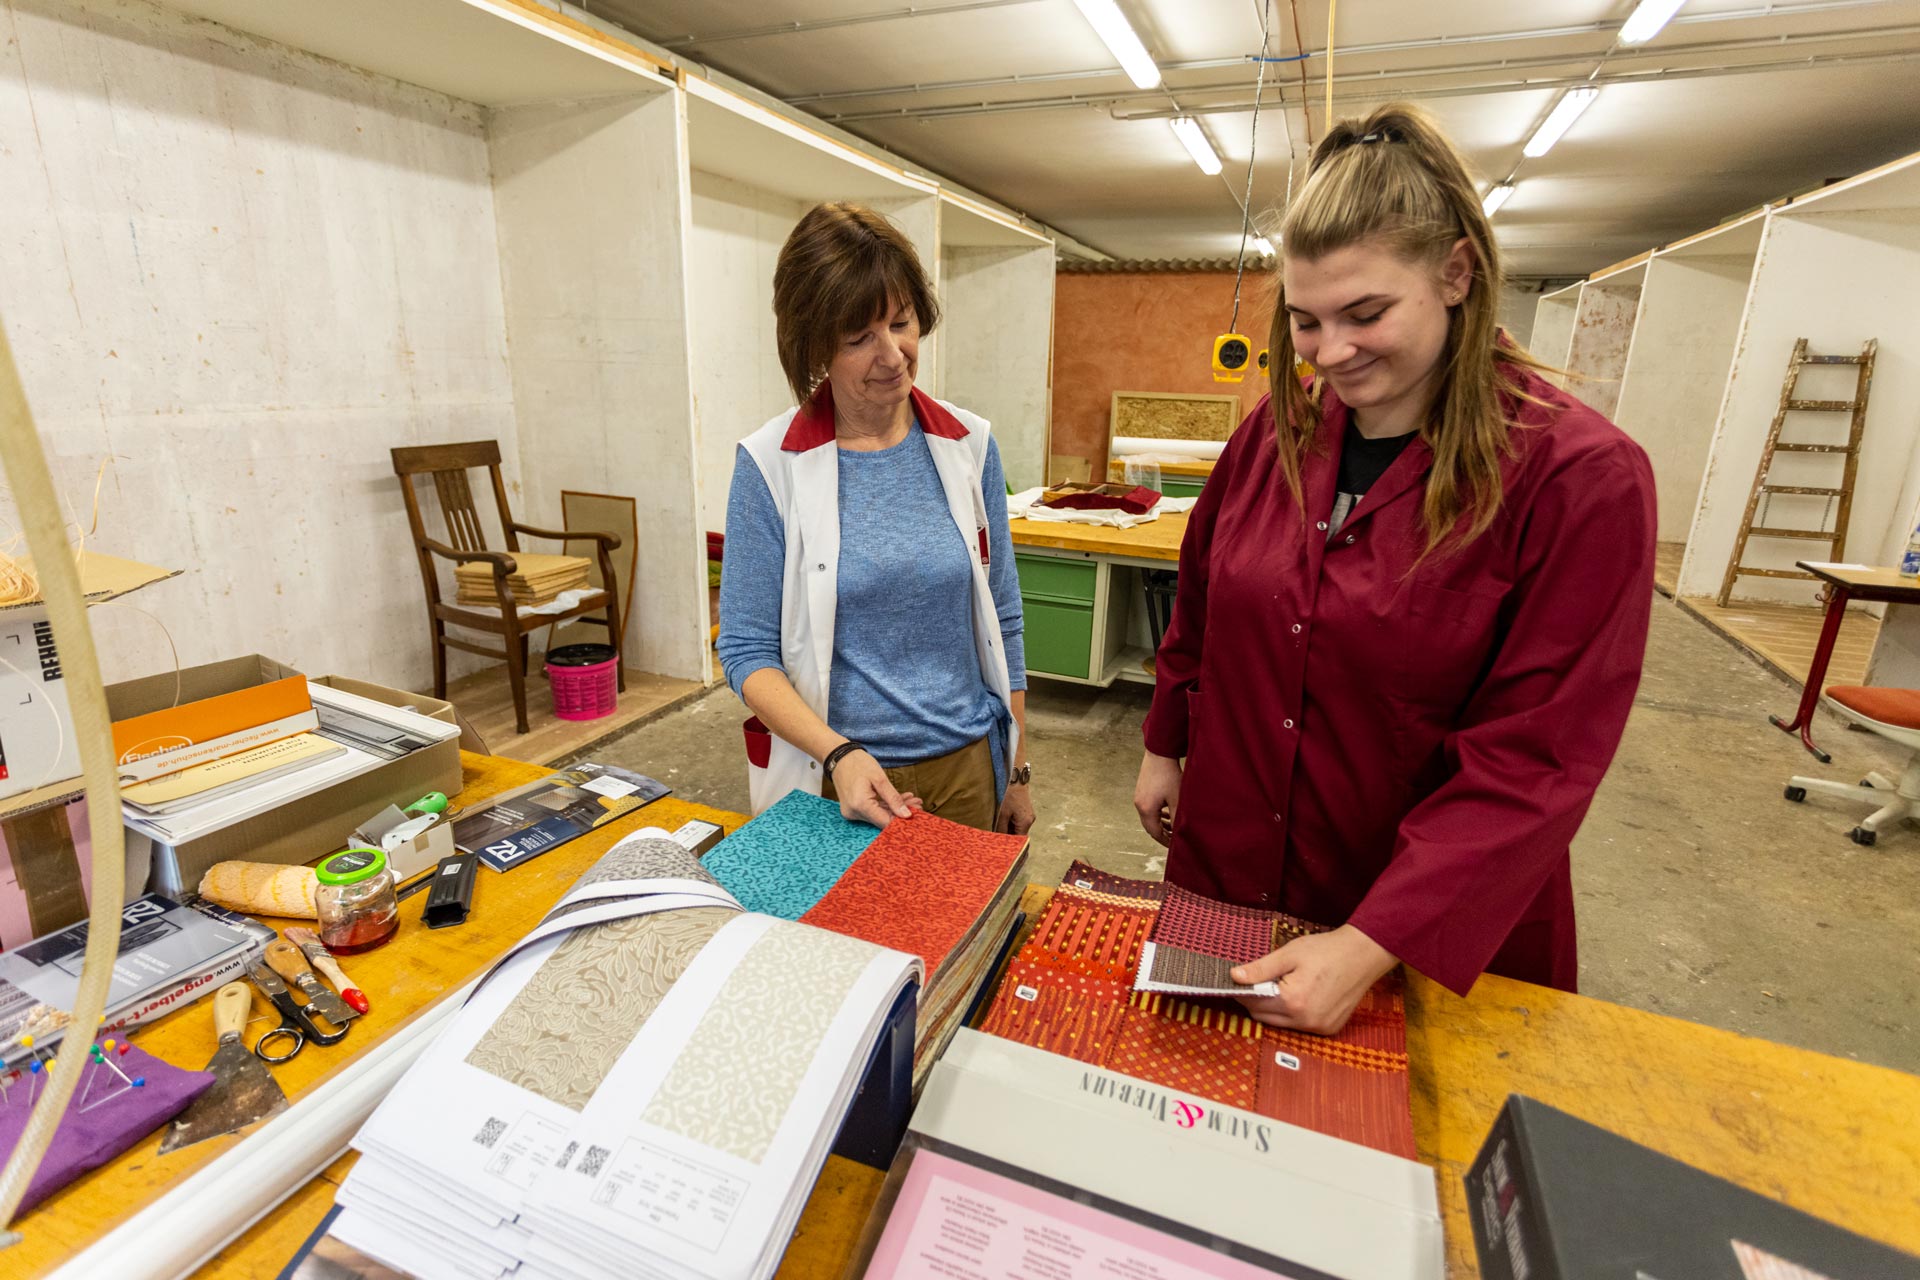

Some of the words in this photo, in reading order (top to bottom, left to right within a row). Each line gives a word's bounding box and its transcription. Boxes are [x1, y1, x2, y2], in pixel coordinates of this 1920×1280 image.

[157, 728, 280, 769] www.fischer-markenschuh.de
[485, 839, 526, 863] RZ
[122, 900, 166, 924] RZ
[1079, 1071, 1167, 1122] VIEBAHN
[1171, 1099, 1204, 1128] &
[1207, 1109, 1272, 1153] SAUM
